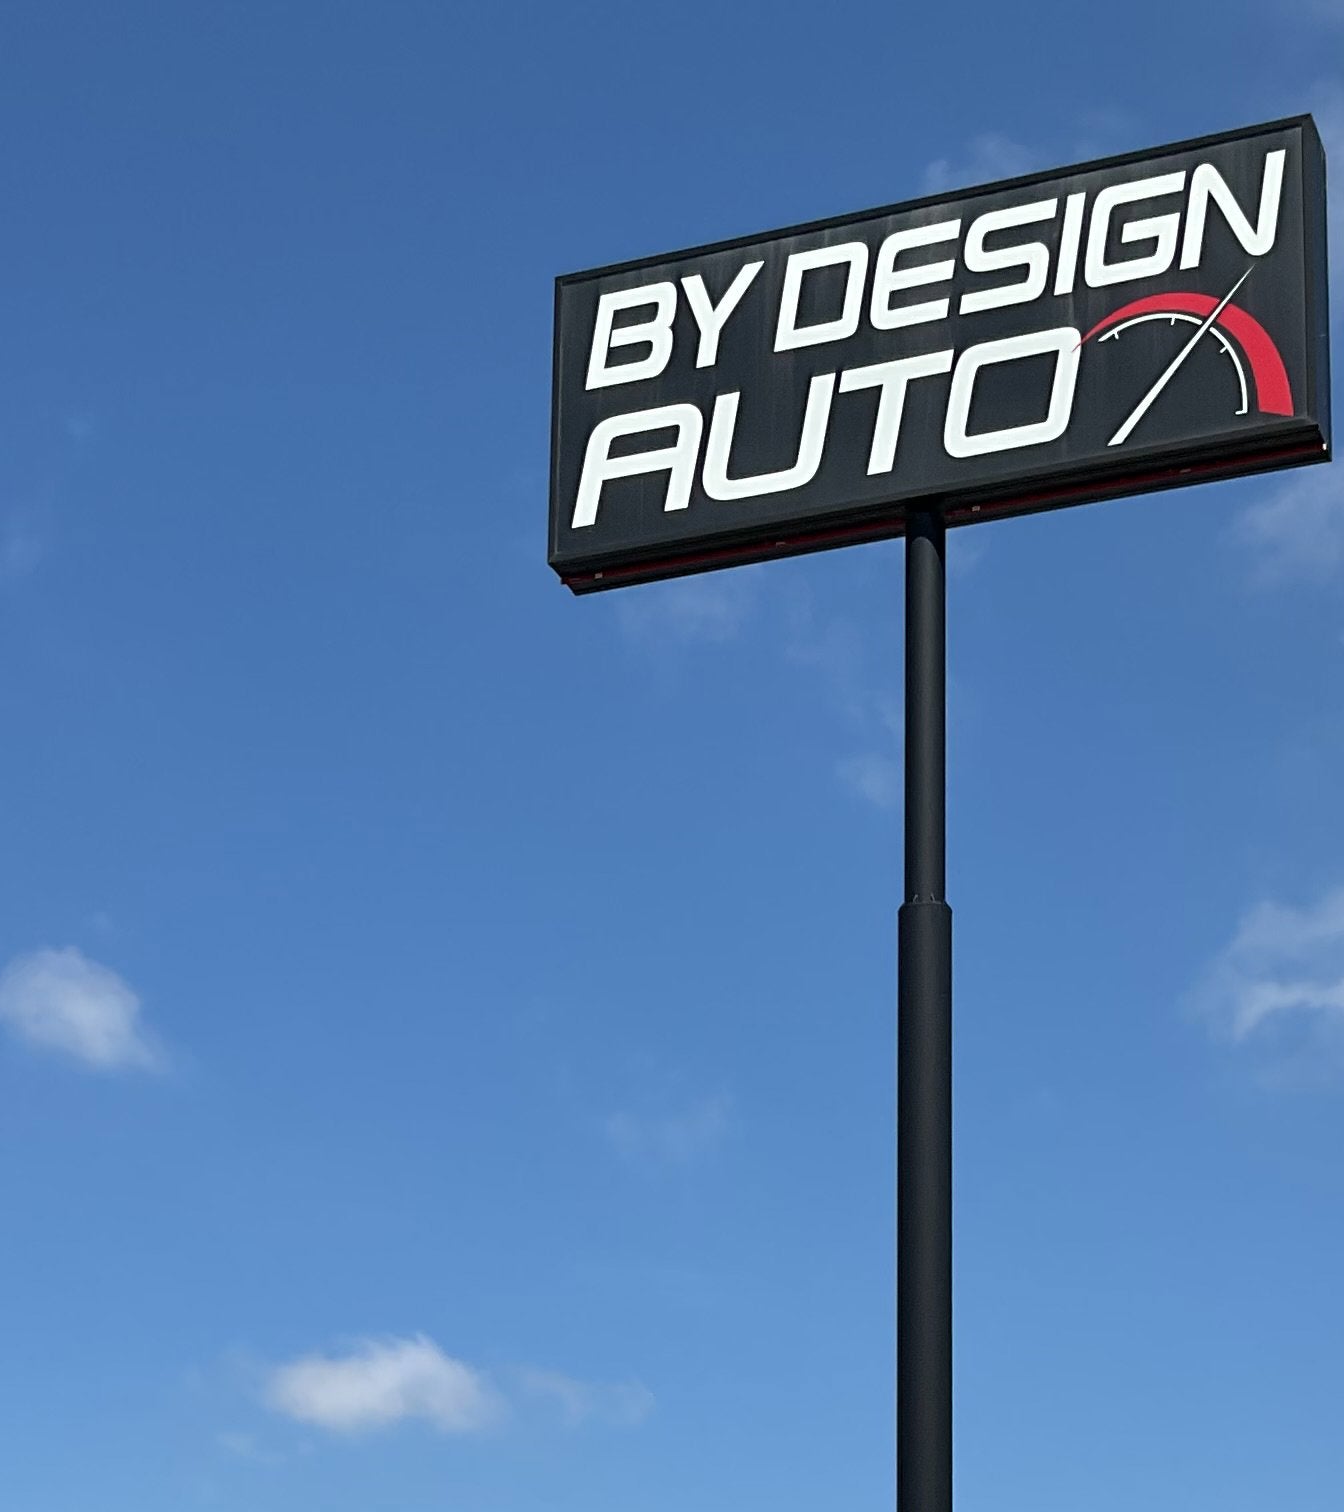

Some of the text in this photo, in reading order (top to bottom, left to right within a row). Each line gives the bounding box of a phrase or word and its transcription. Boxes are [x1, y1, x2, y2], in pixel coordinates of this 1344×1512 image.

[585, 149, 1286, 390] BY DESIGN
[571, 327, 1081, 528] AUTO
